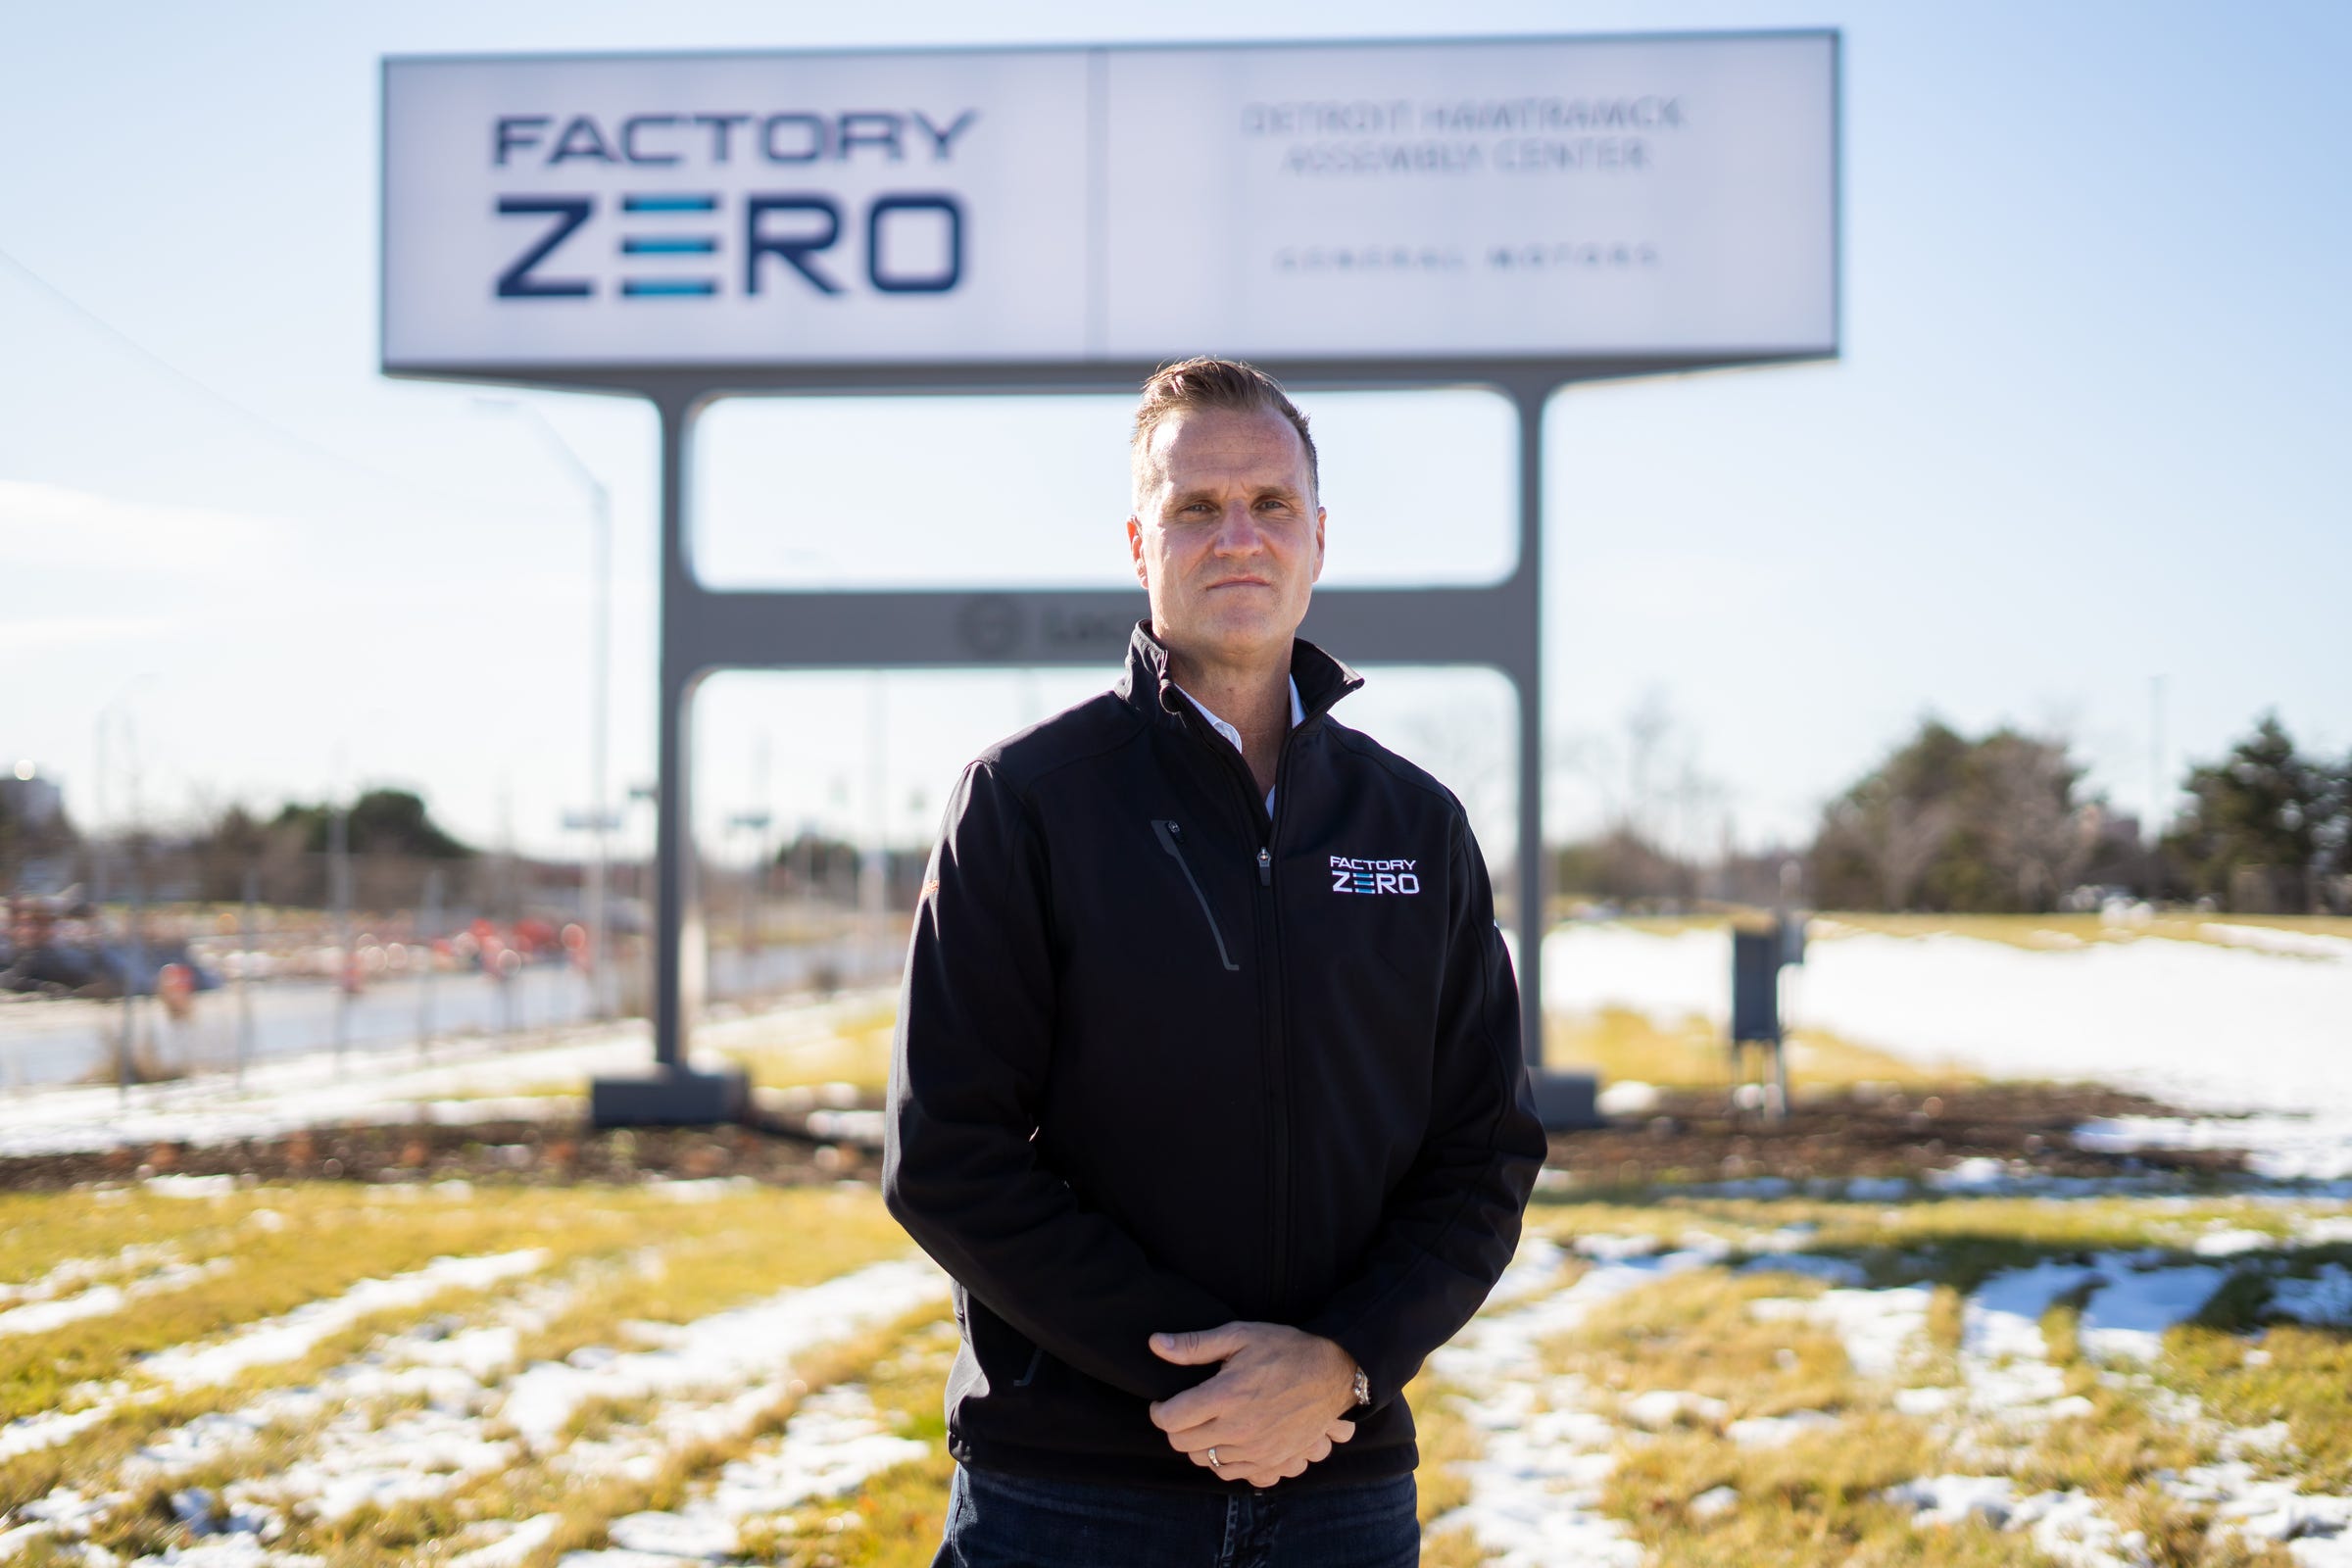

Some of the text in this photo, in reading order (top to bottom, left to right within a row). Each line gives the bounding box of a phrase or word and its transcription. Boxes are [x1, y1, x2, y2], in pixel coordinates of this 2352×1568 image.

[1242, 101, 1412, 135] DETROIT
[494, 109, 981, 166] FACTORY
[1282, 137, 1652, 173] ASSEMBLY CENTER
[494, 191, 967, 297] ZERO
[1330, 856, 1416, 870] FACTORY
[1332, 870, 1419, 894] ZERO
